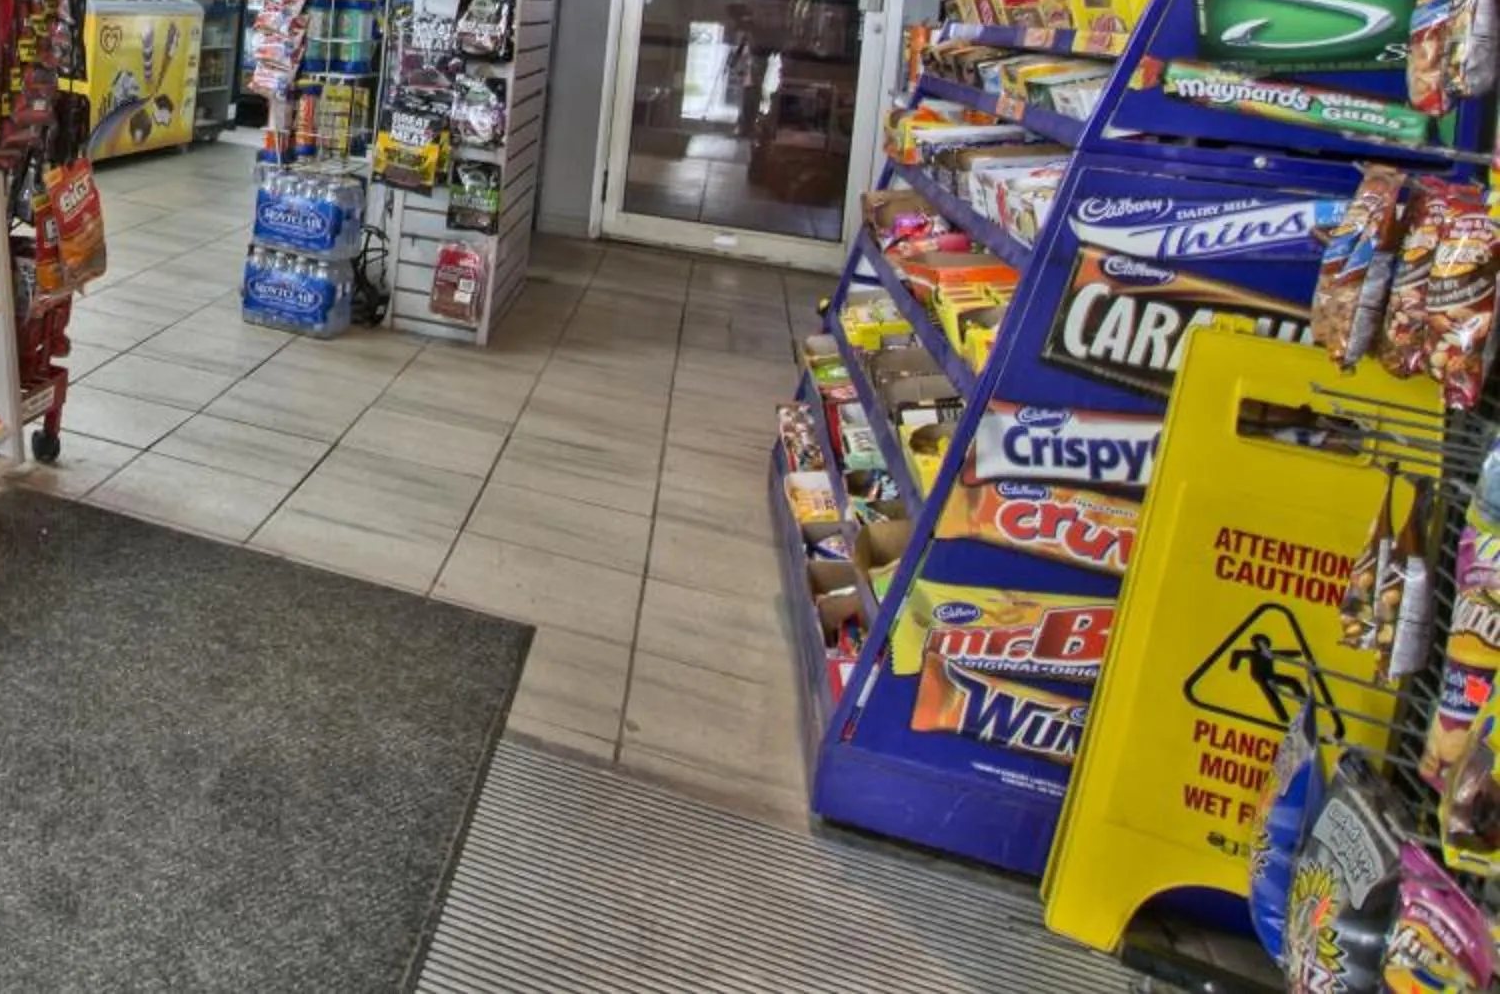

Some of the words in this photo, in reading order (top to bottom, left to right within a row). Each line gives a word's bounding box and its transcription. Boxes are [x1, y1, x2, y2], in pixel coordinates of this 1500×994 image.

[1321, 107, 1402, 130] Gums
[1079, 197, 1173, 222] Cadbury
[1176, 206, 1220, 221] DAIRY
[1128, 209, 1308, 262] Thins
[1103, 256, 1176, 282] Cadbury
[1018, 407, 1070, 425] Cadbury
[1003, 425, 1150, 484] Crispy
[999, 482, 1045, 498] Cadbury
[1213, 526, 1355, 581] ATTENTION
[1215, 554, 1348, 606] CAUTION
[1184, 784, 1232, 815] WET
